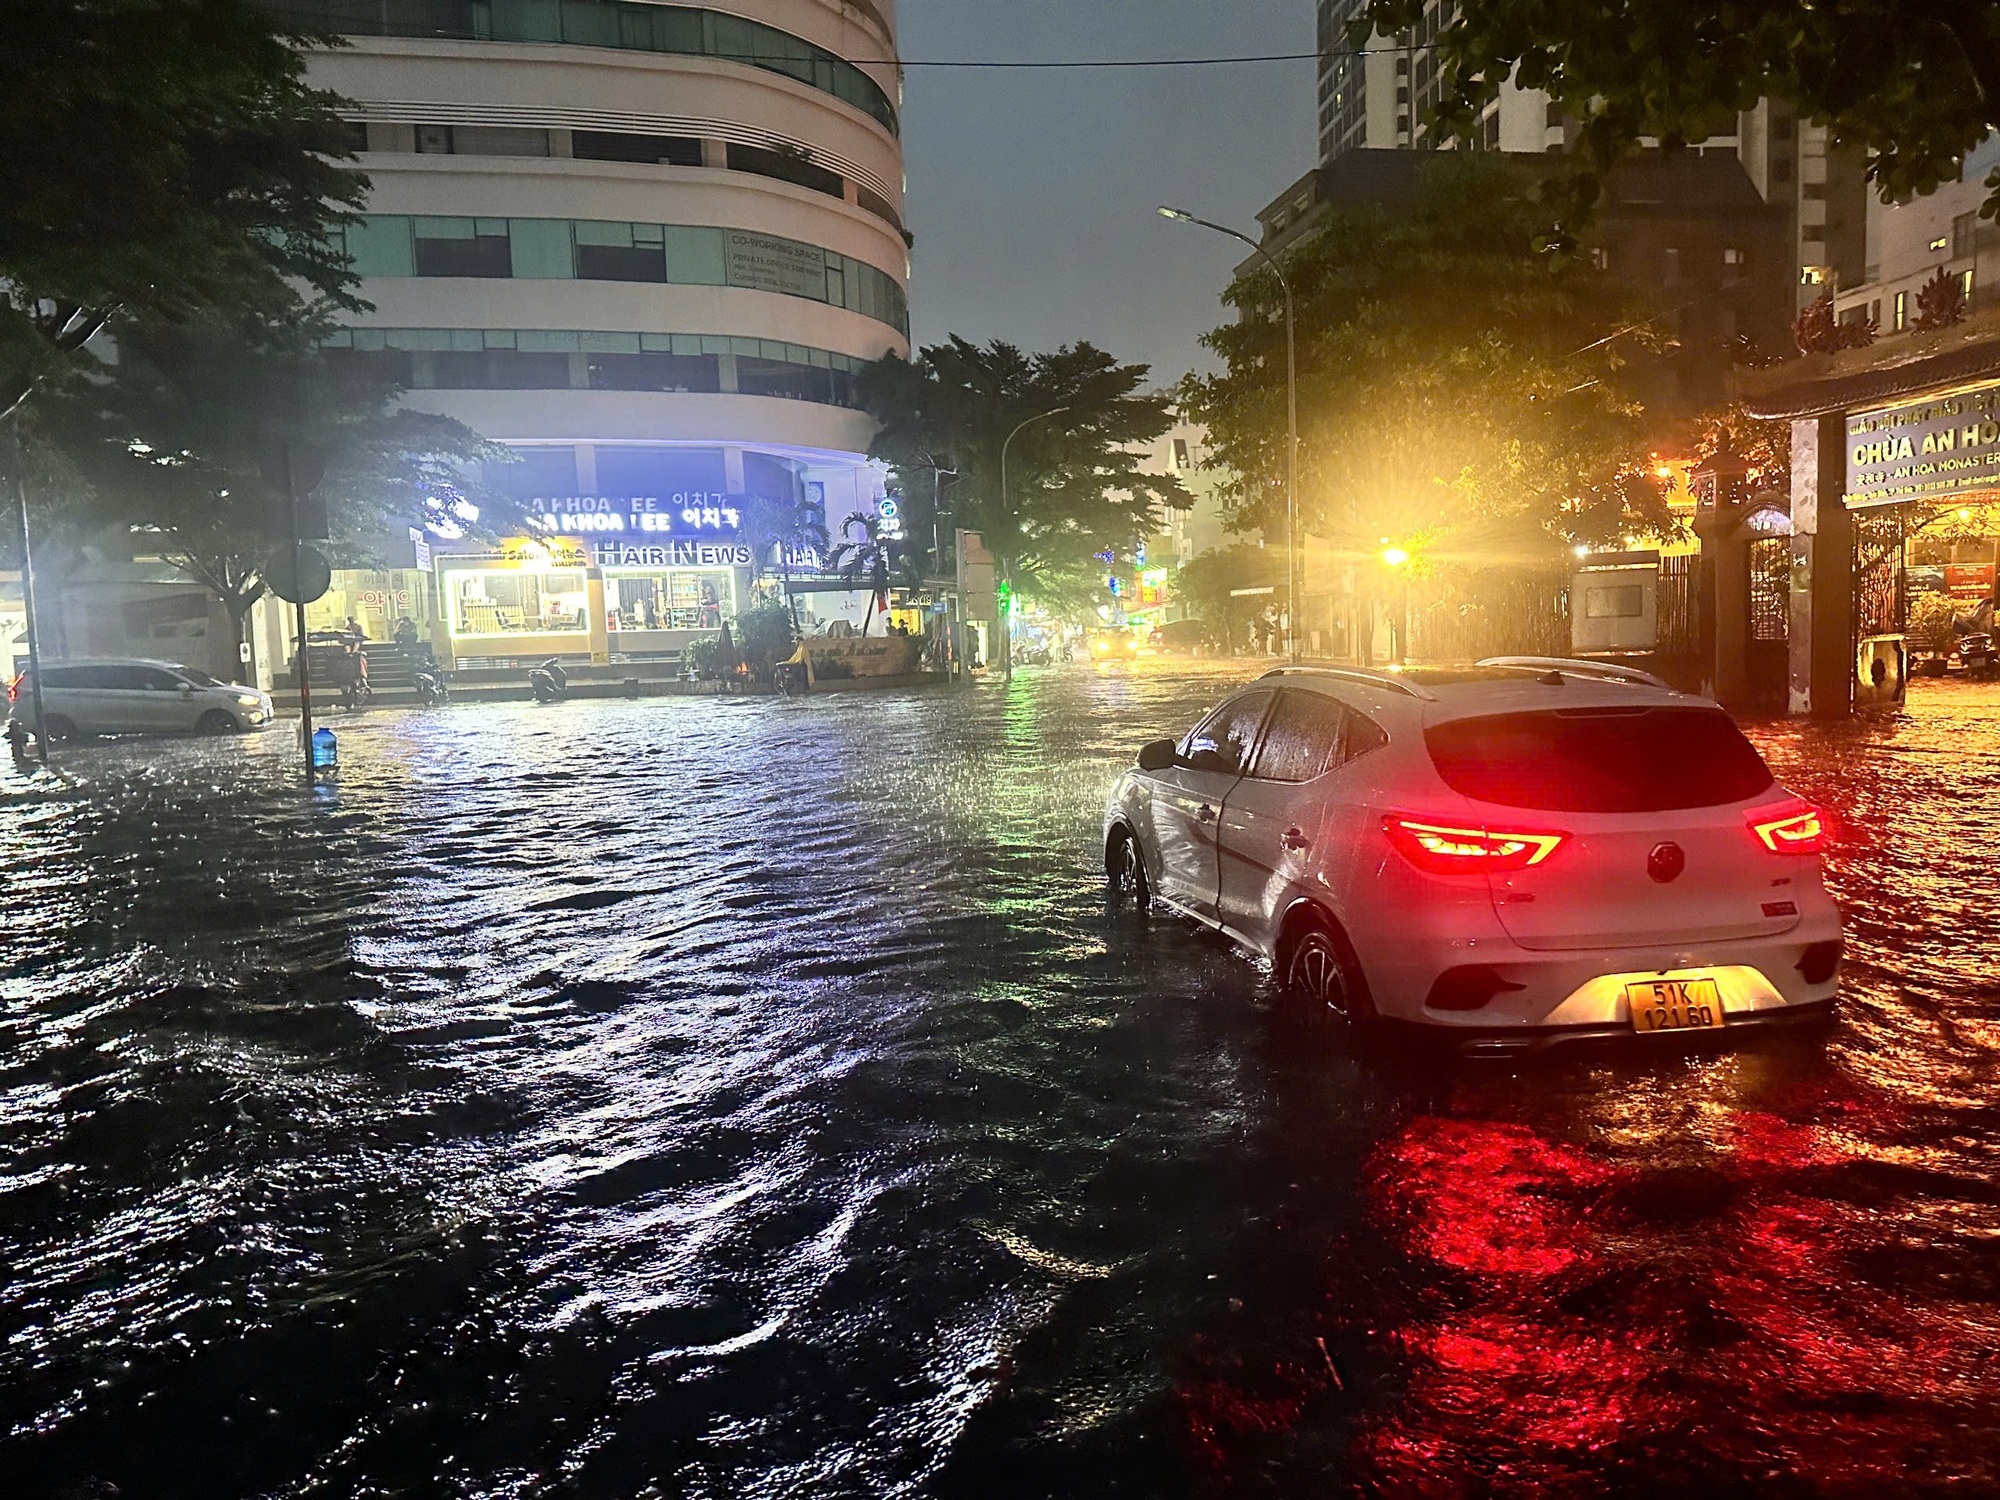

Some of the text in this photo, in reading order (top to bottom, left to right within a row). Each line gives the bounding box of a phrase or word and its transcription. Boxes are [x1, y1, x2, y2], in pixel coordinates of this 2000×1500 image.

[732, 235, 821, 263] CO-WORKING SPACE
[732, 253, 766, 265] PRIVATE
[1852, 413, 2000, 467] CHÙA AN HÒ
[1893, 466, 1911, 480] AN
[1912, 460, 1936, 478] HOA
[561, 512, 624, 532] KHOA
[595, 539, 751, 566] HAIR NEWS
[1652, 983, 1693, 1005] 51K
